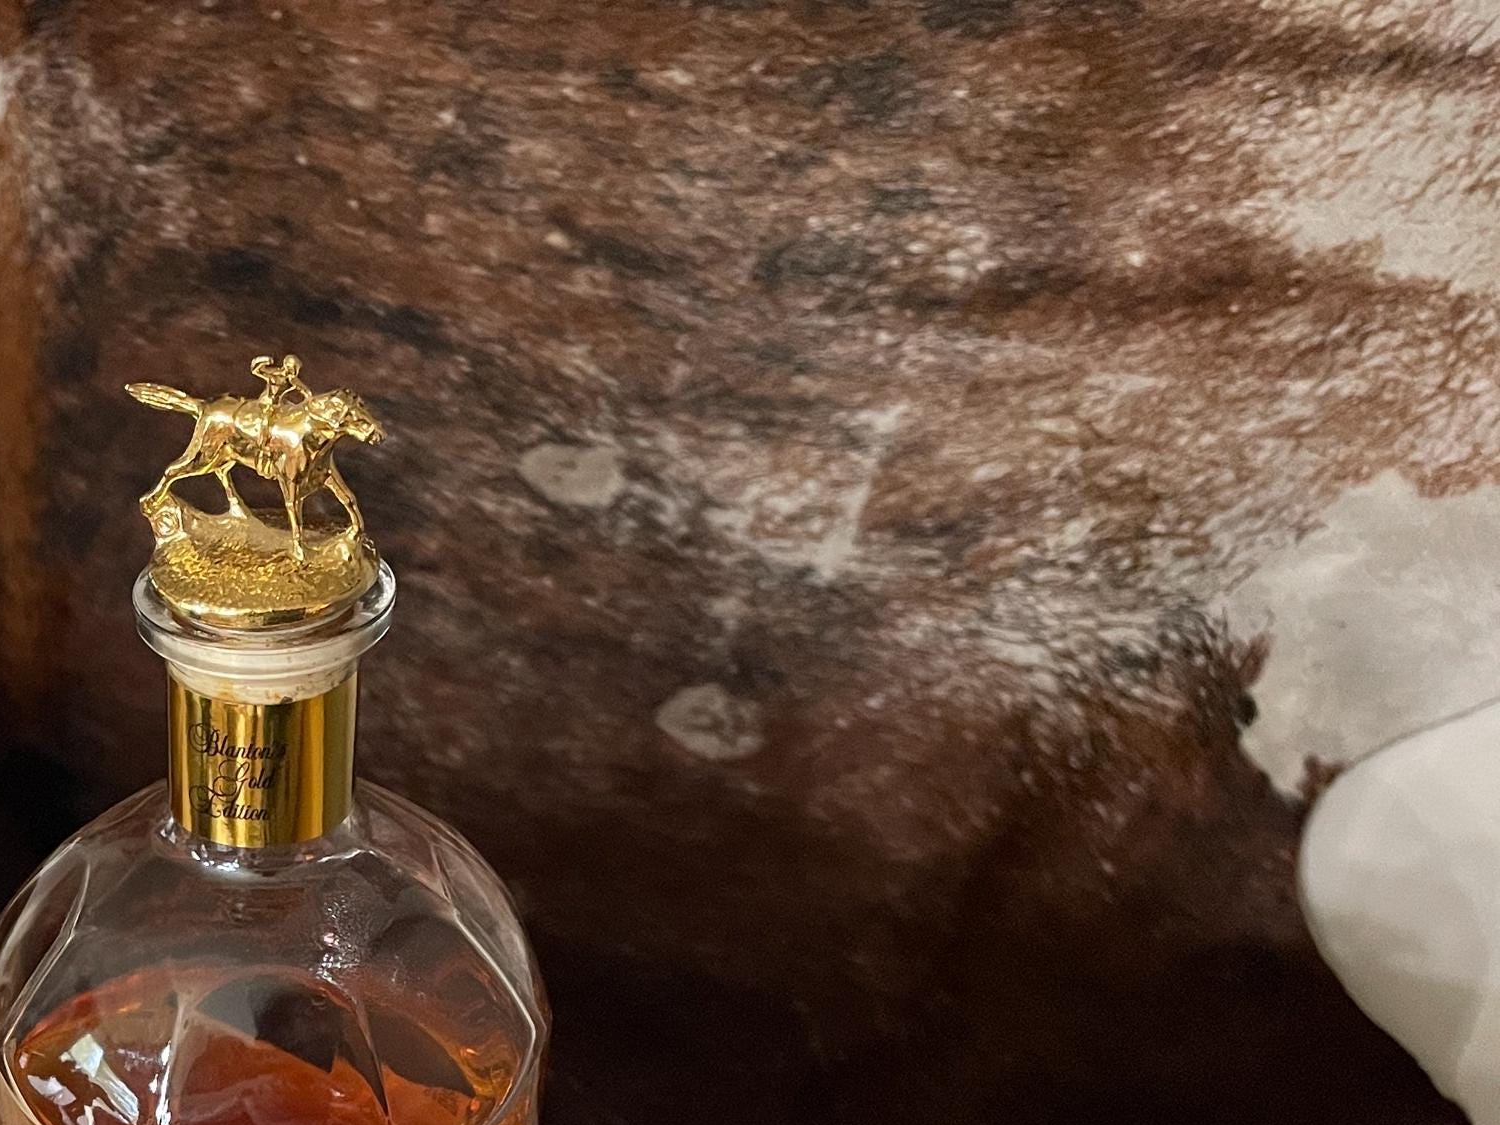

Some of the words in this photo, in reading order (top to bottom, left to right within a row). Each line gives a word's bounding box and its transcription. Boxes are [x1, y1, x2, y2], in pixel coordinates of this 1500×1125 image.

[188, 722, 287, 760] Blanton's
[212, 759, 276, 805] Gold
[188, 784, 270, 820] Edition
